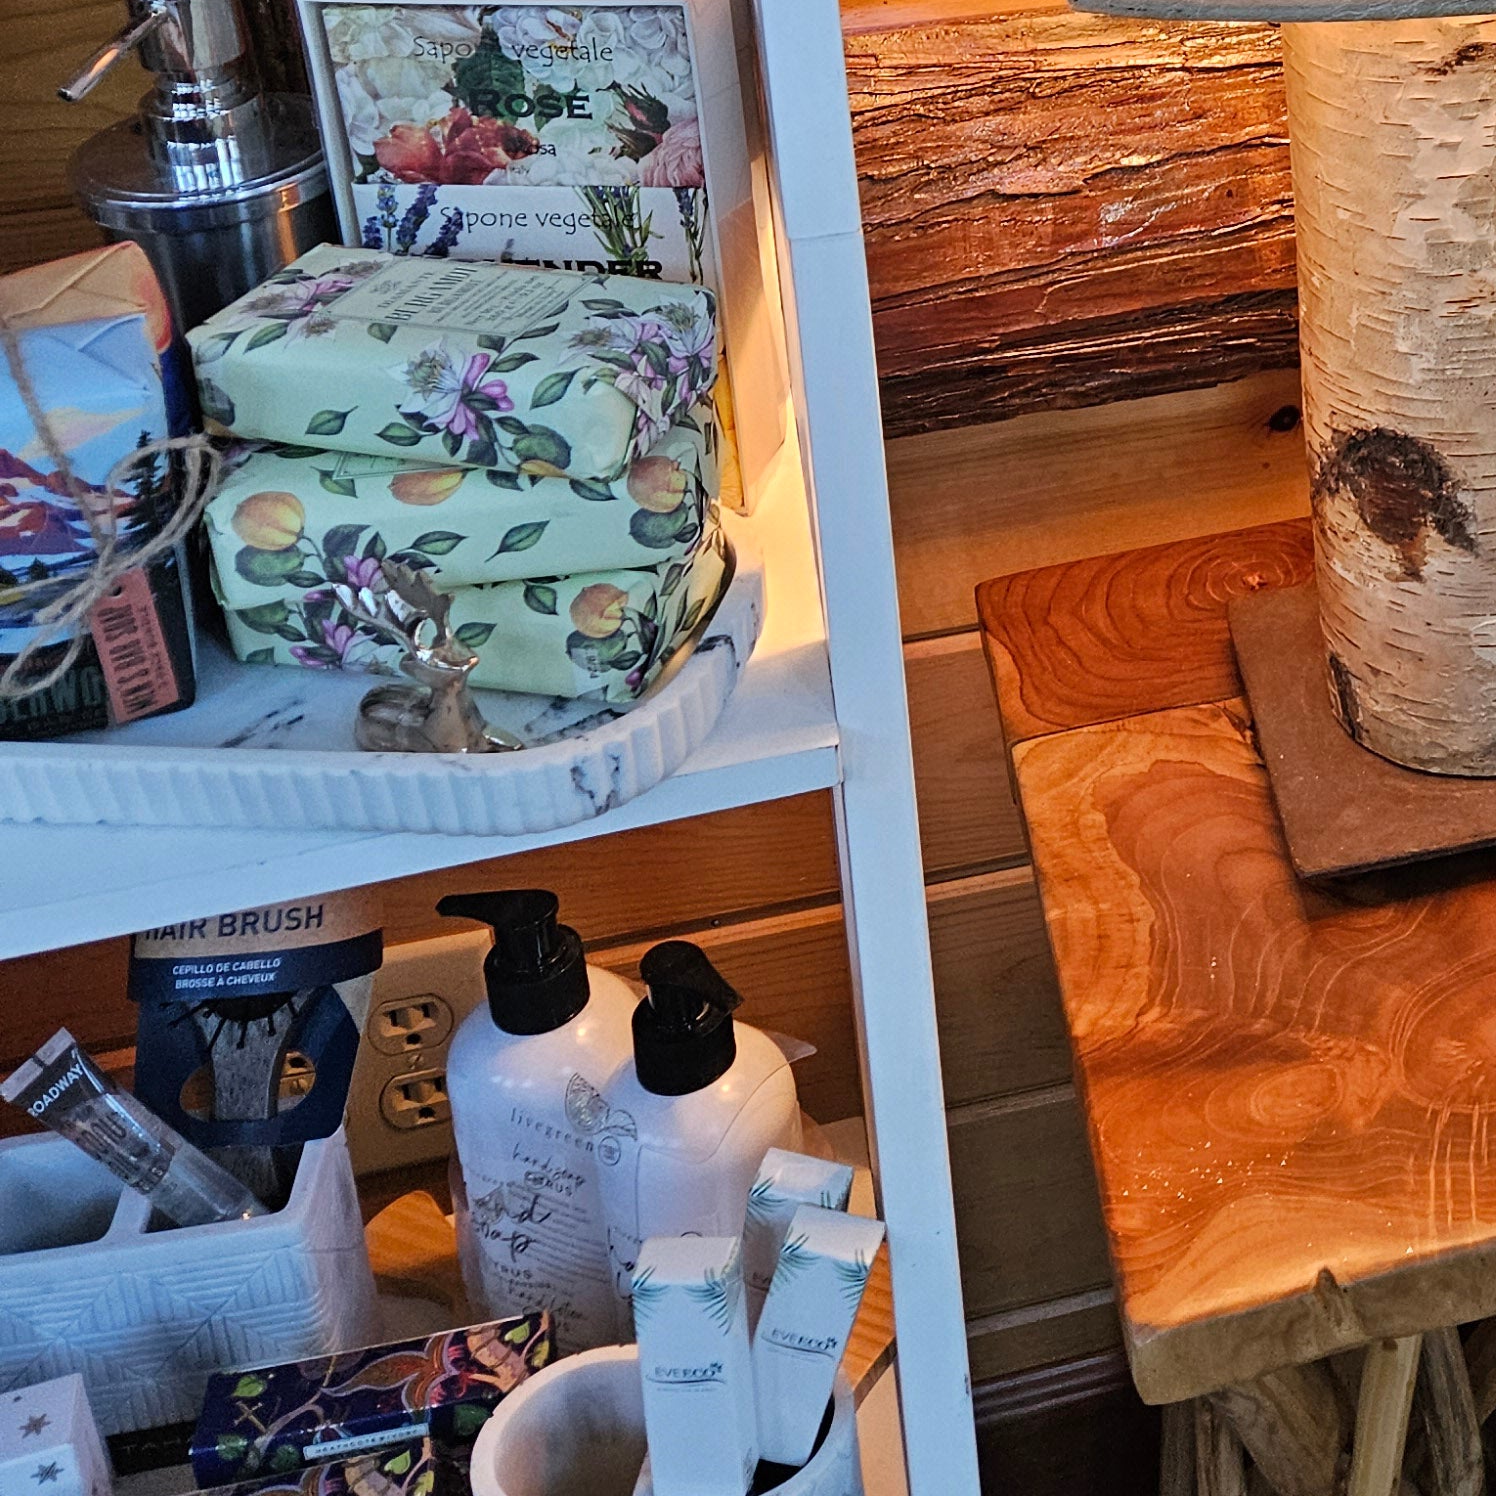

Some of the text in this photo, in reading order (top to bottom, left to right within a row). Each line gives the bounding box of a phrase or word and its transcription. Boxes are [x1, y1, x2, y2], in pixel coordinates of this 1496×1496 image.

[413, 35, 614, 67] Sapo vegetale
[468, 88, 593, 120] ROSE
[440, 206, 529, 234] Spone
[217, 904, 324, 938] BRUSH
[172, 957, 282, 976] CEPILLO DE CABELLO
[175, 977, 216, 990] BROSSE
[226, 971, 276, 985] CHEVEUX
[511, 1107, 595, 1153] livegreen
